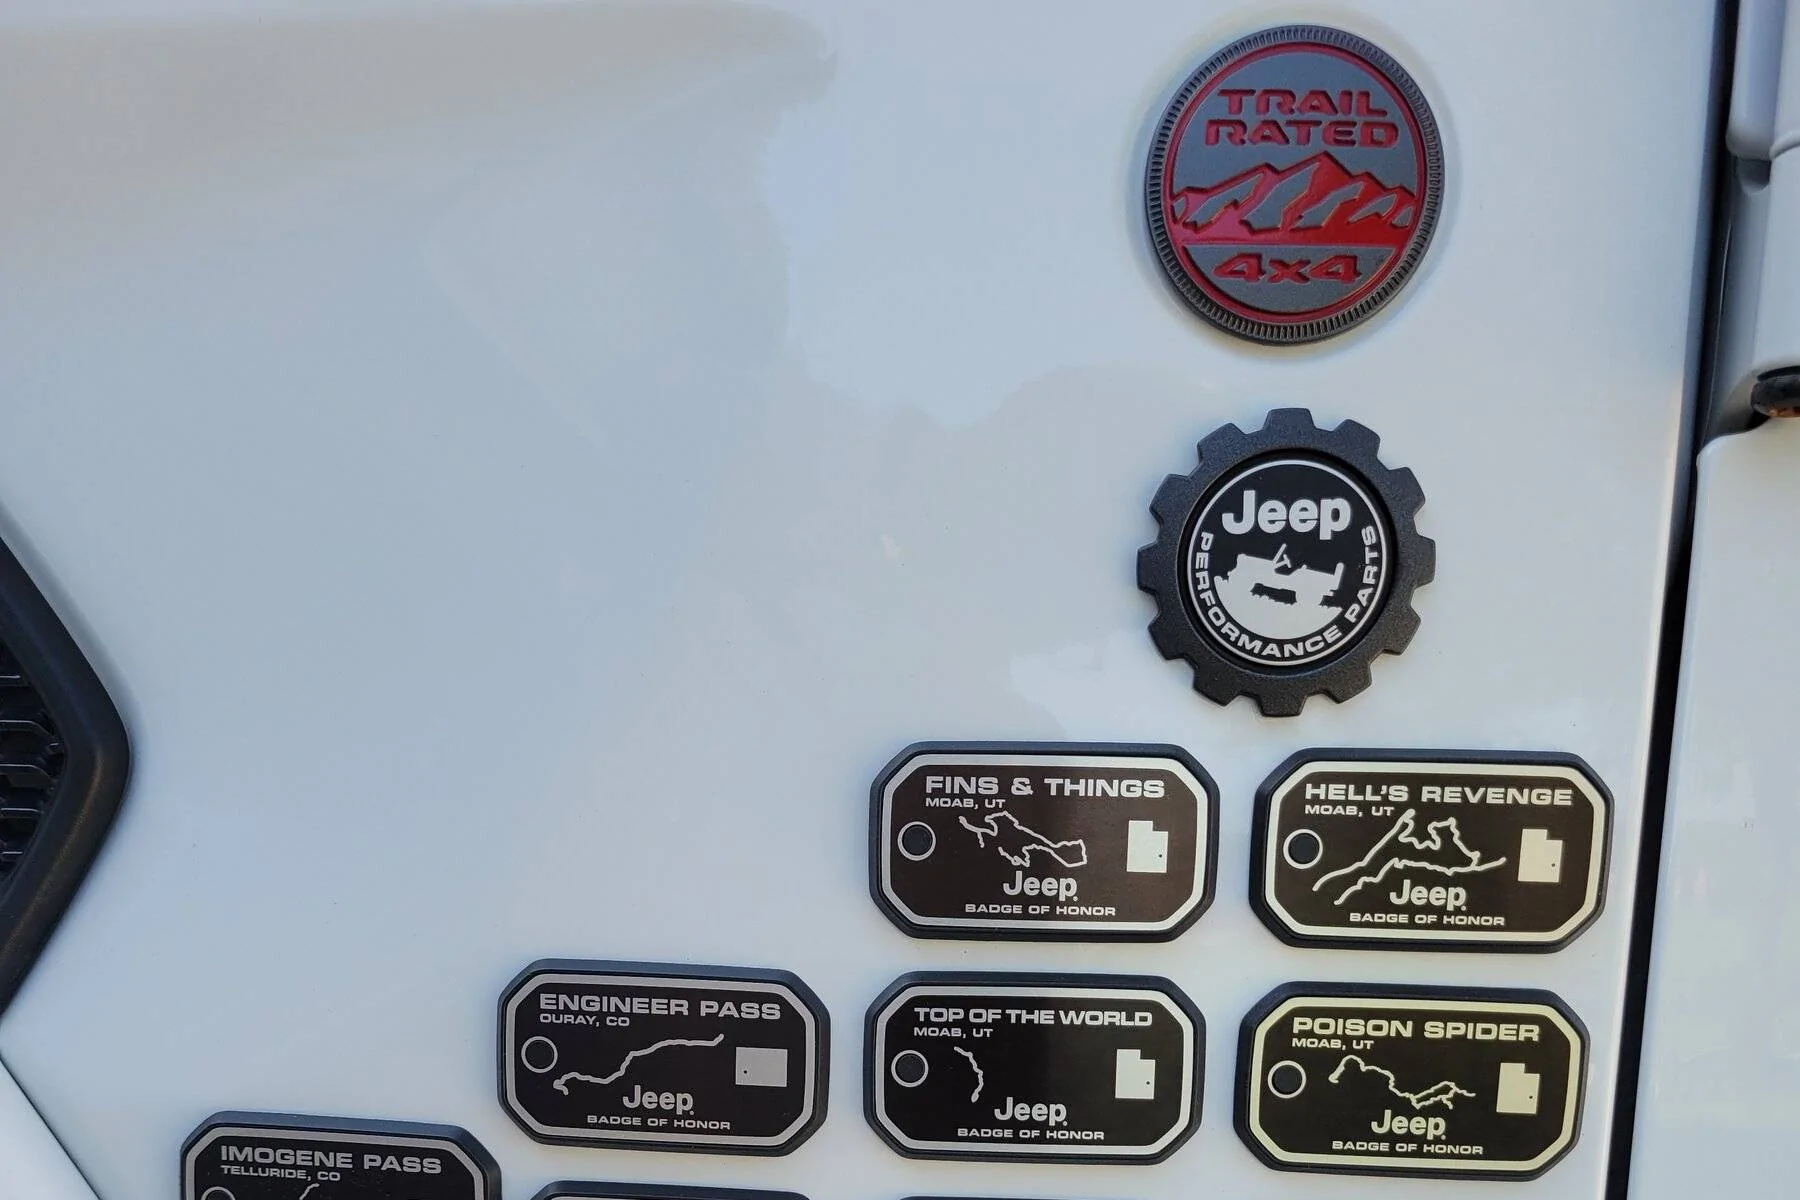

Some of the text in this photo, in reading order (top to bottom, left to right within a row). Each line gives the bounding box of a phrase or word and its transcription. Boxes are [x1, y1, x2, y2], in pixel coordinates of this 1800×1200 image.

[1217, 88, 1388, 117] TRAIL
[1204, 119, 1399, 148] RATED
[1213, 253, 1361, 284] 4x4
[1222, 490, 1351, 540] Jeep
[1195, 525, 1377, 658] PERFORMANCE PARTS
[926, 776, 1165, 798] FINS & THINGS
[1305, 783, 1573, 806] HELL'S REVENGE
[926, 798, 1006, 810] MOAB, UT
[1305, 804, 1395, 817] MOAB, UT
[1003, 870, 1077, 902] Jeep
[1390, 879, 1466, 911] Jeep
[965, 904, 1116, 916] BADGE OF HONOR
[1350, 913, 1505, 926] BADGE OF HONOR
[540, 993, 781, 1020] ENGINEER PASS
[914, 1008, 1153, 1026] TOP OF THE WORLD
[540, 1013, 630, 1027] OURAY, CO
[1293, 1017, 1540, 1042] POISON SPIDER
[914, 1027, 993, 1039] MOAB, UT
[1292, 1038, 1374, 1050] MOAB, UT
[622, 1085, 693, 1115] Jeep
[994, 1097, 1067, 1126] Jeep
[587, 1115, 730, 1130] BADGE OF HONOR
[958, 1128, 1104, 1140] BADGE OF HONOR
[1371, 1109, 1446, 1140] Jeep
[220, 1145, 441, 1174] IMOGENE PASS
[1332, 1141, 1483, 1155] BADGE OF HONOR
[220, 1165, 341, 1181] TELLURIDE, CO
